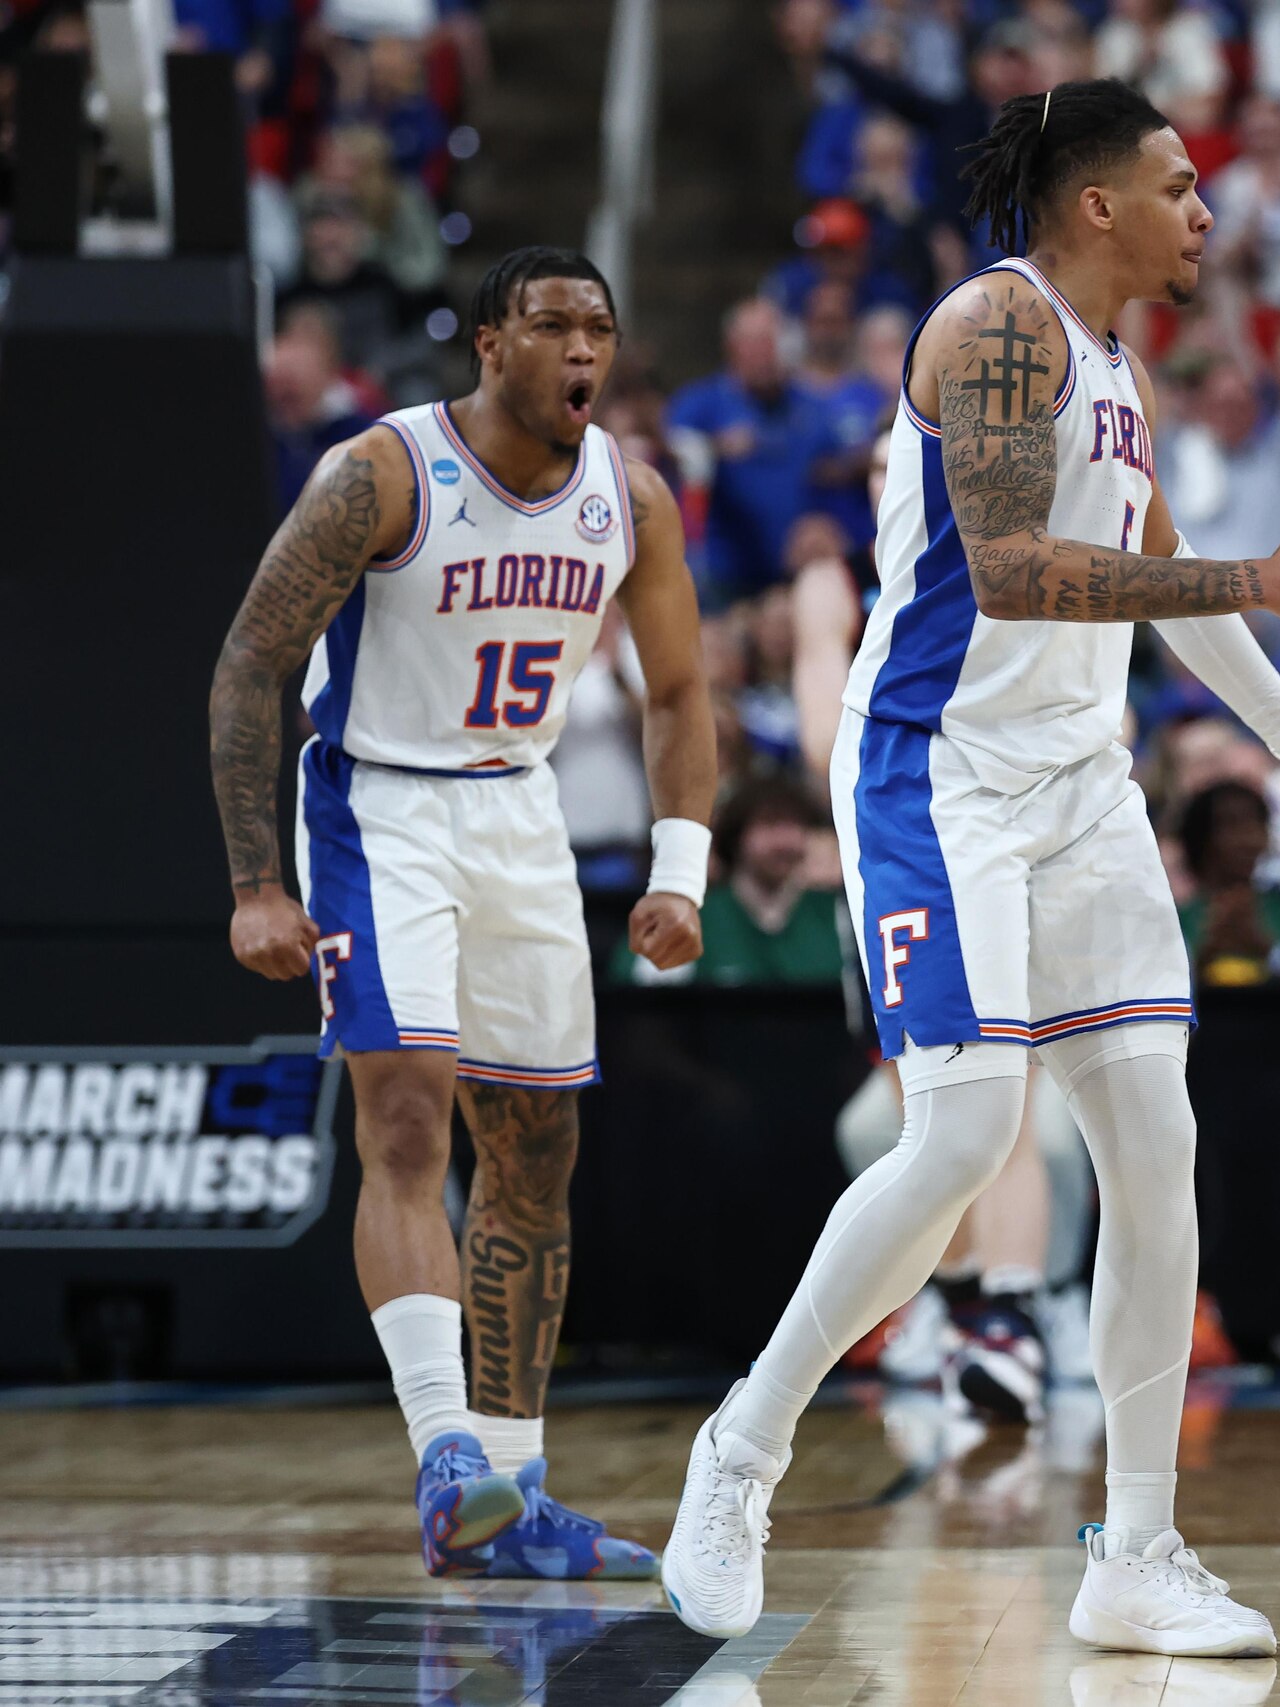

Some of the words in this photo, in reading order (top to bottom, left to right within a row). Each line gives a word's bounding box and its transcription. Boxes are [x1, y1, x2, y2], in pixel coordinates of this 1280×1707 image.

[436, 553, 606, 615] FLORIDA
[969, 544, 1028, 575] Gaga
[464, 639, 565, 730] 15
[315, 930, 352, 1020] F
[878, 907, 930, 1010] F
[0, 1133, 317, 1213] MADNESS
